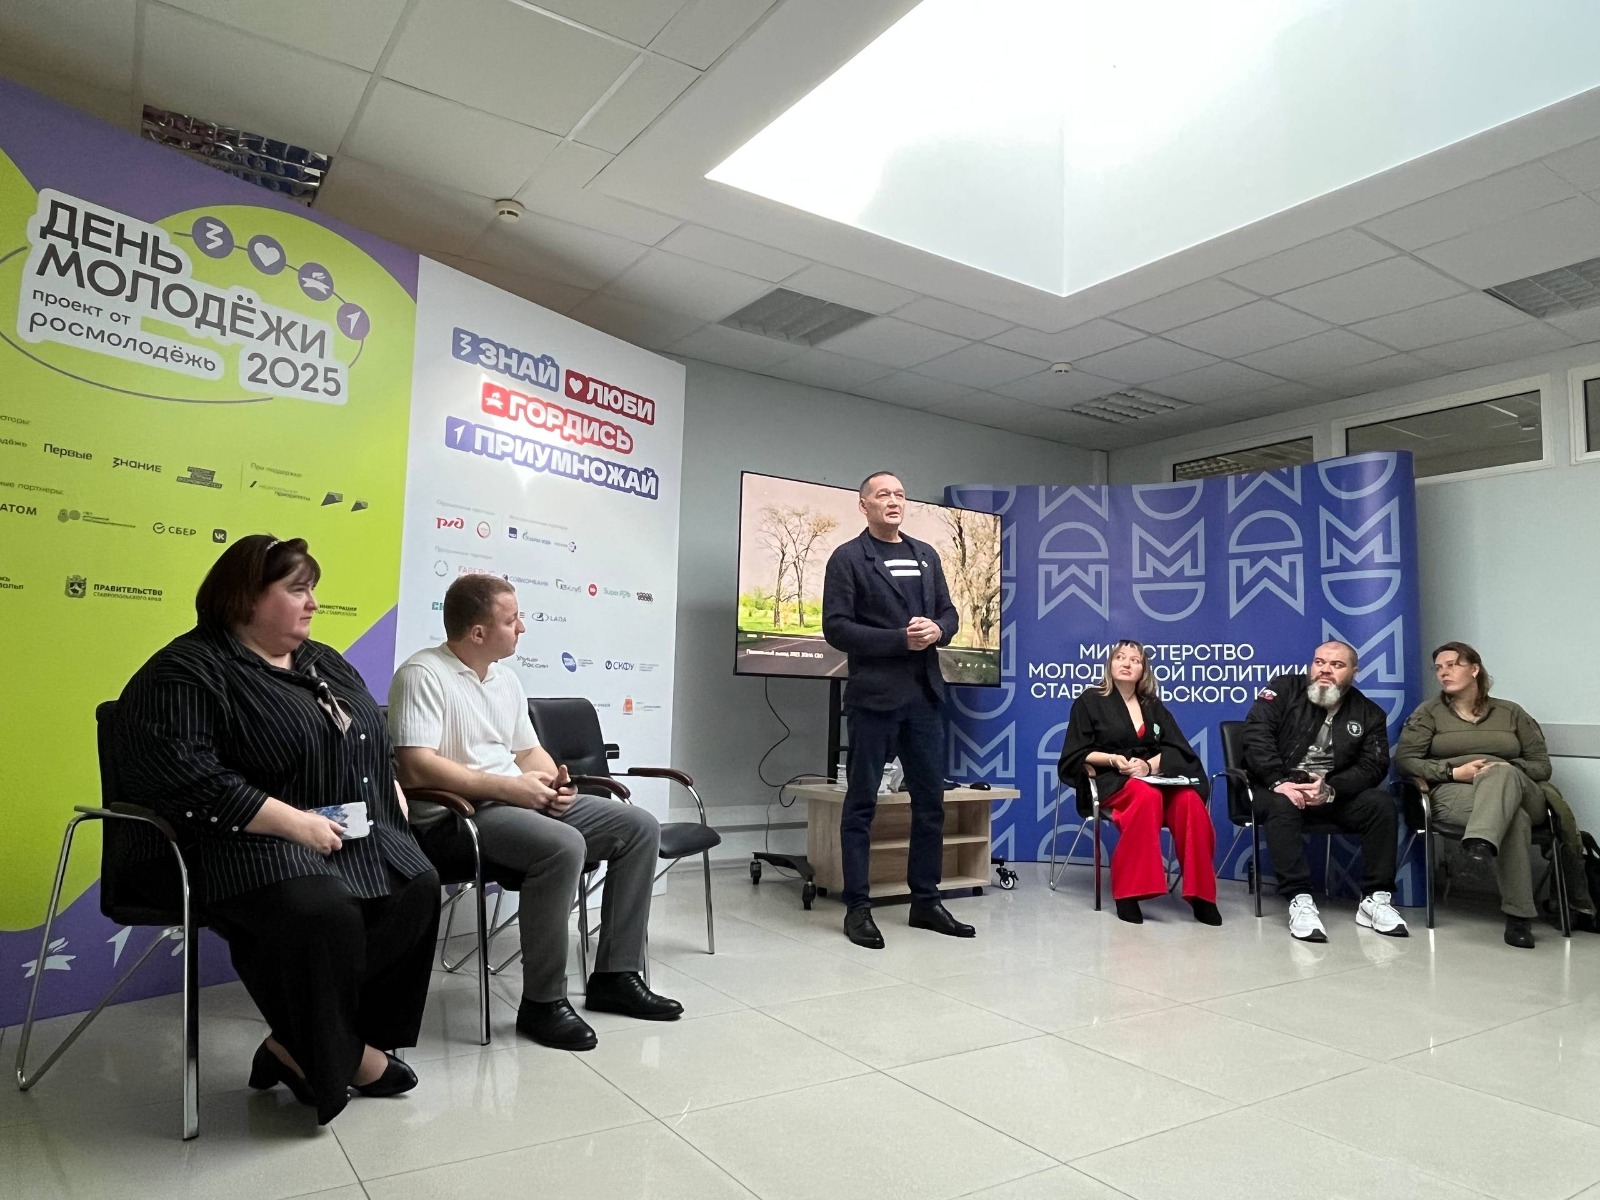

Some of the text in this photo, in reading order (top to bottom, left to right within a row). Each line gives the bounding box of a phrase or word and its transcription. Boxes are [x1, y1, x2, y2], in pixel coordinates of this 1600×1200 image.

[39, 199, 183, 275] ДЕНЬ
[33, 289, 131, 326] проект от
[36, 243, 327, 359] МОЛОДЁЖИ
[29, 311, 216, 373] росмолодёжь
[247, 352, 341, 397] 2025
[478, 342, 557, 388] ЗНАЙ
[586, 382, 654, 421] ЛЮБИ
[508, 395, 632, 451] ГОРДИСЬ
[43, 443, 93, 460] Первые
[474, 427, 657, 496] ПРИУМНОЖАЙ
[168, 526, 197, 536] СБЕР
[93, 583, 163, 596] ПРАВИТЕЛЬСТВО
[550, 615, 567, 623] LADA
[613, 661, 635, 671] СКФУ
[1079, 643, 1255, 661] МИСТЕРСТВО
[1028, 662, 1185, 682] МОЛОДОЙ
[1030, 682, 1248, 703] СТАВЬСКОГО
